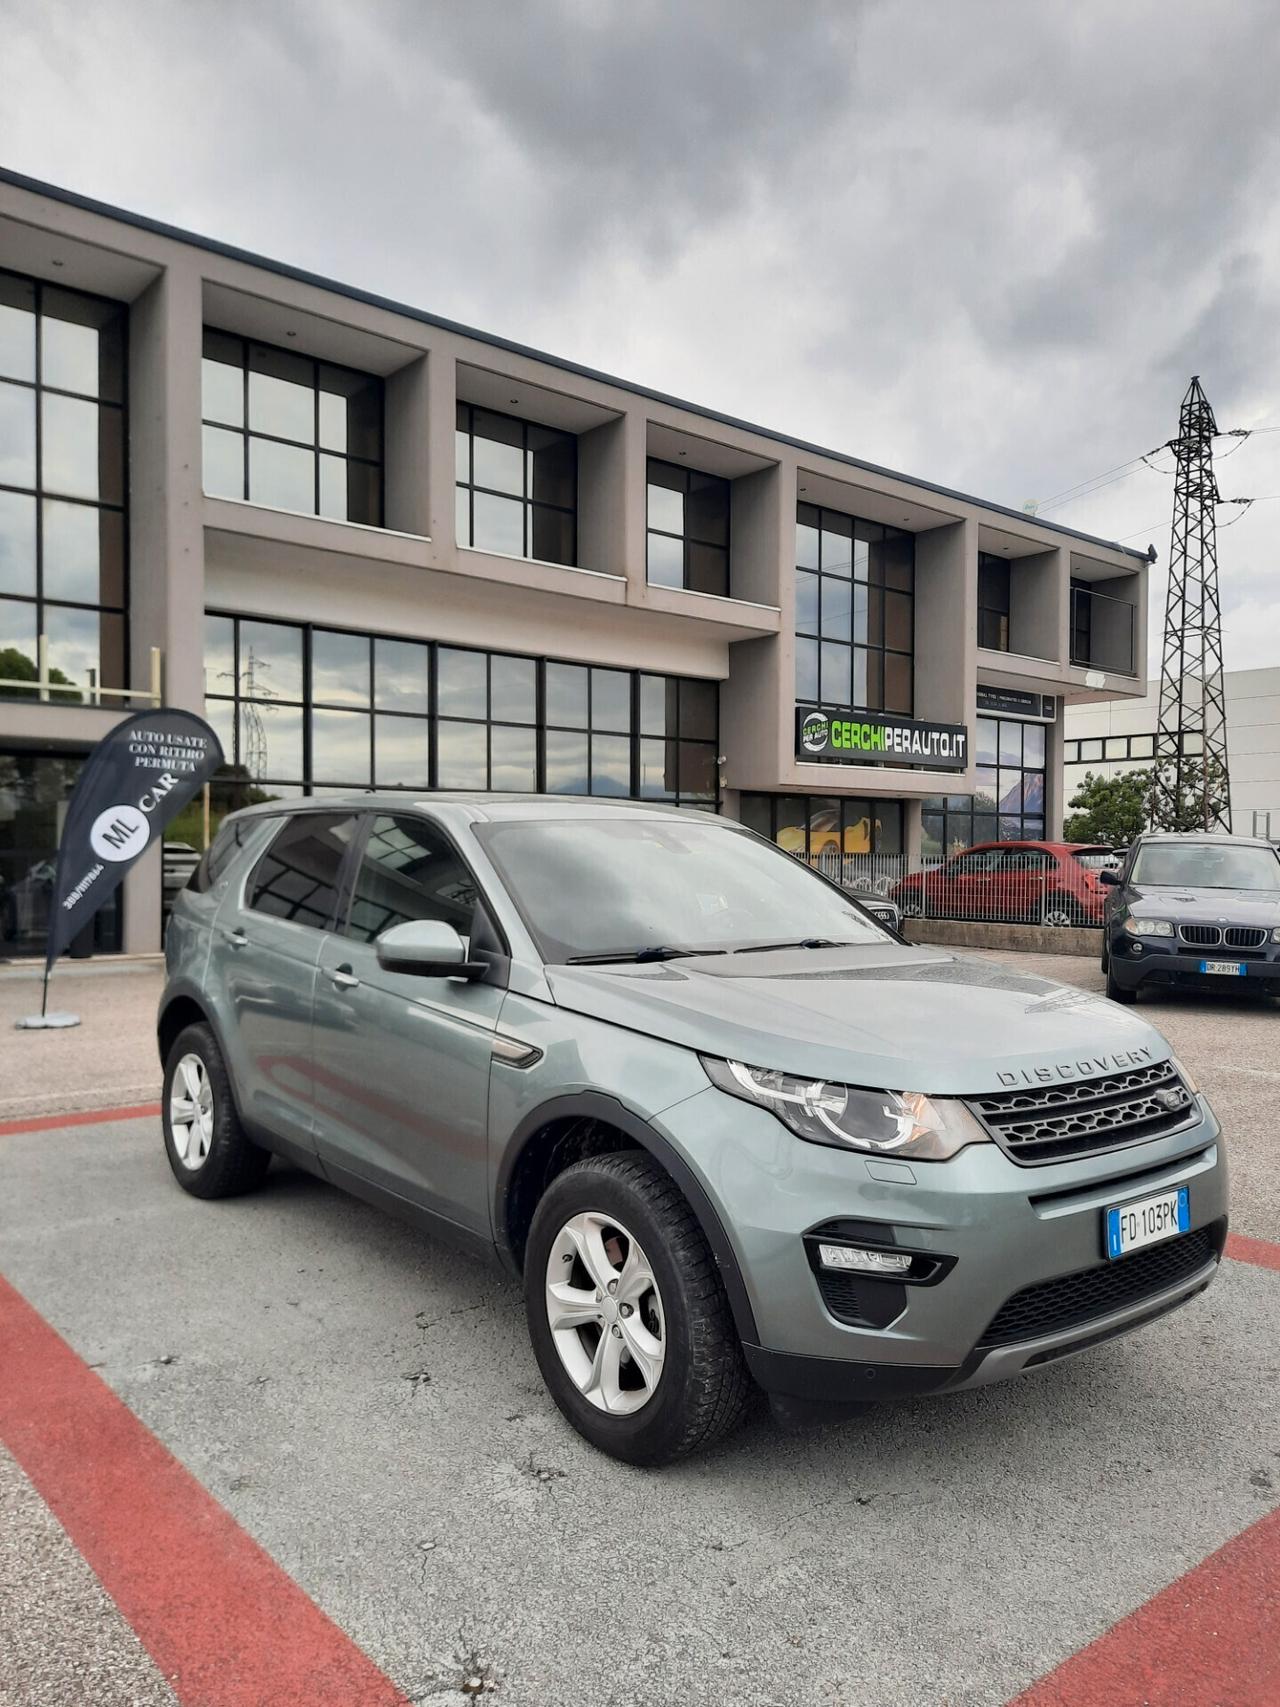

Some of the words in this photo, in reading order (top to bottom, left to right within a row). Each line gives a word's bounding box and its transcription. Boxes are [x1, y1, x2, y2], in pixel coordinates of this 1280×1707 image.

[129, 730, 165, 743] AUTO
[166, 733, 208, 749] USATE
[802, 721, 829, 736] CERCHI
[831, 720, 966, 758] CERCHIPERAUTO.IT
[128, 743, 157, 755] CON
[159, 745, 205, 760] RITIRO
[134, 756, 196, 772] PERMUTA
[138, 772, 180, 813] CAR
[101, 818, 140, 850] ML
[996, 1046, 1153, 1087] DISCOVERY
[1120, 1212, 1137, 1245] FD
[1141, 1199, 1178, 1237] 103PK
